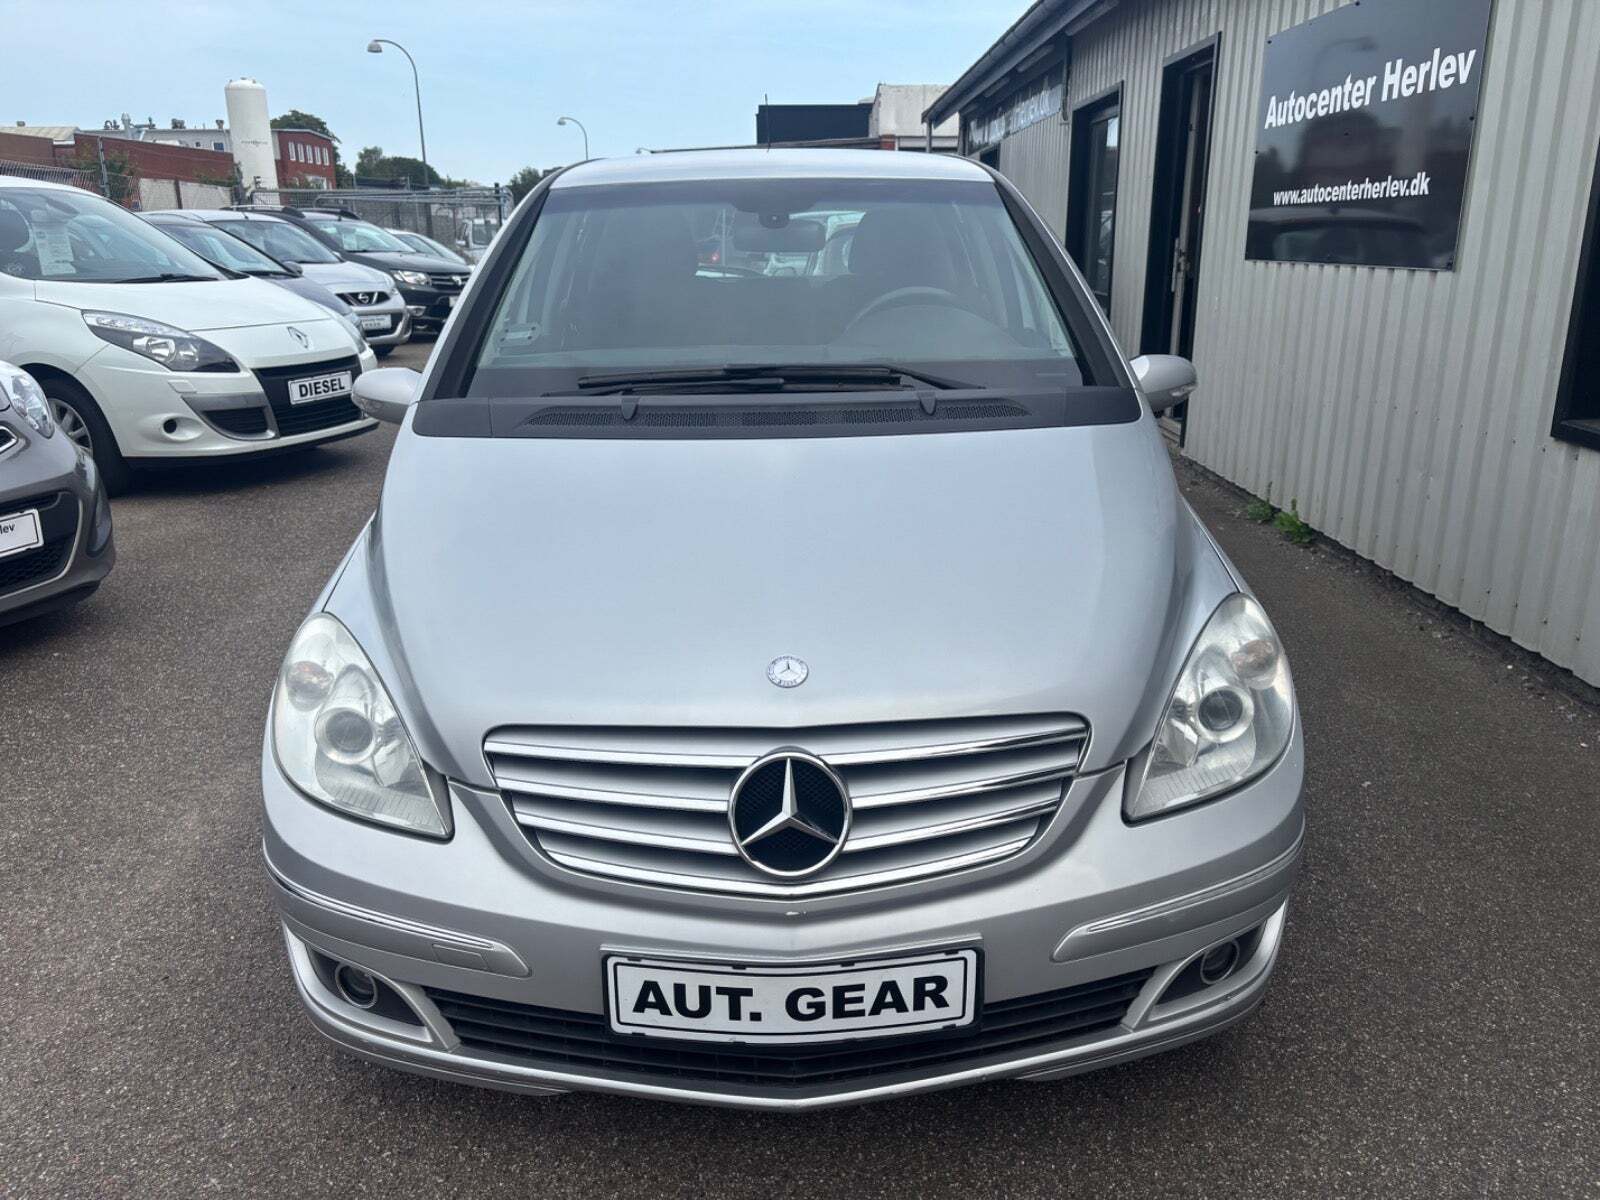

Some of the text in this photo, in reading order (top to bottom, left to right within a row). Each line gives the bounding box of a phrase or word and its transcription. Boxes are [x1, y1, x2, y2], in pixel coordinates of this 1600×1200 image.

[1264, 47, 1477, 129] Autocenter Herlev
[1273, 171, 1431, 206] www.autocenterherlev.dk
[298, 378, 345, 398] DIESEL
[631, 975, 951, 1022] AUT. GEAR
